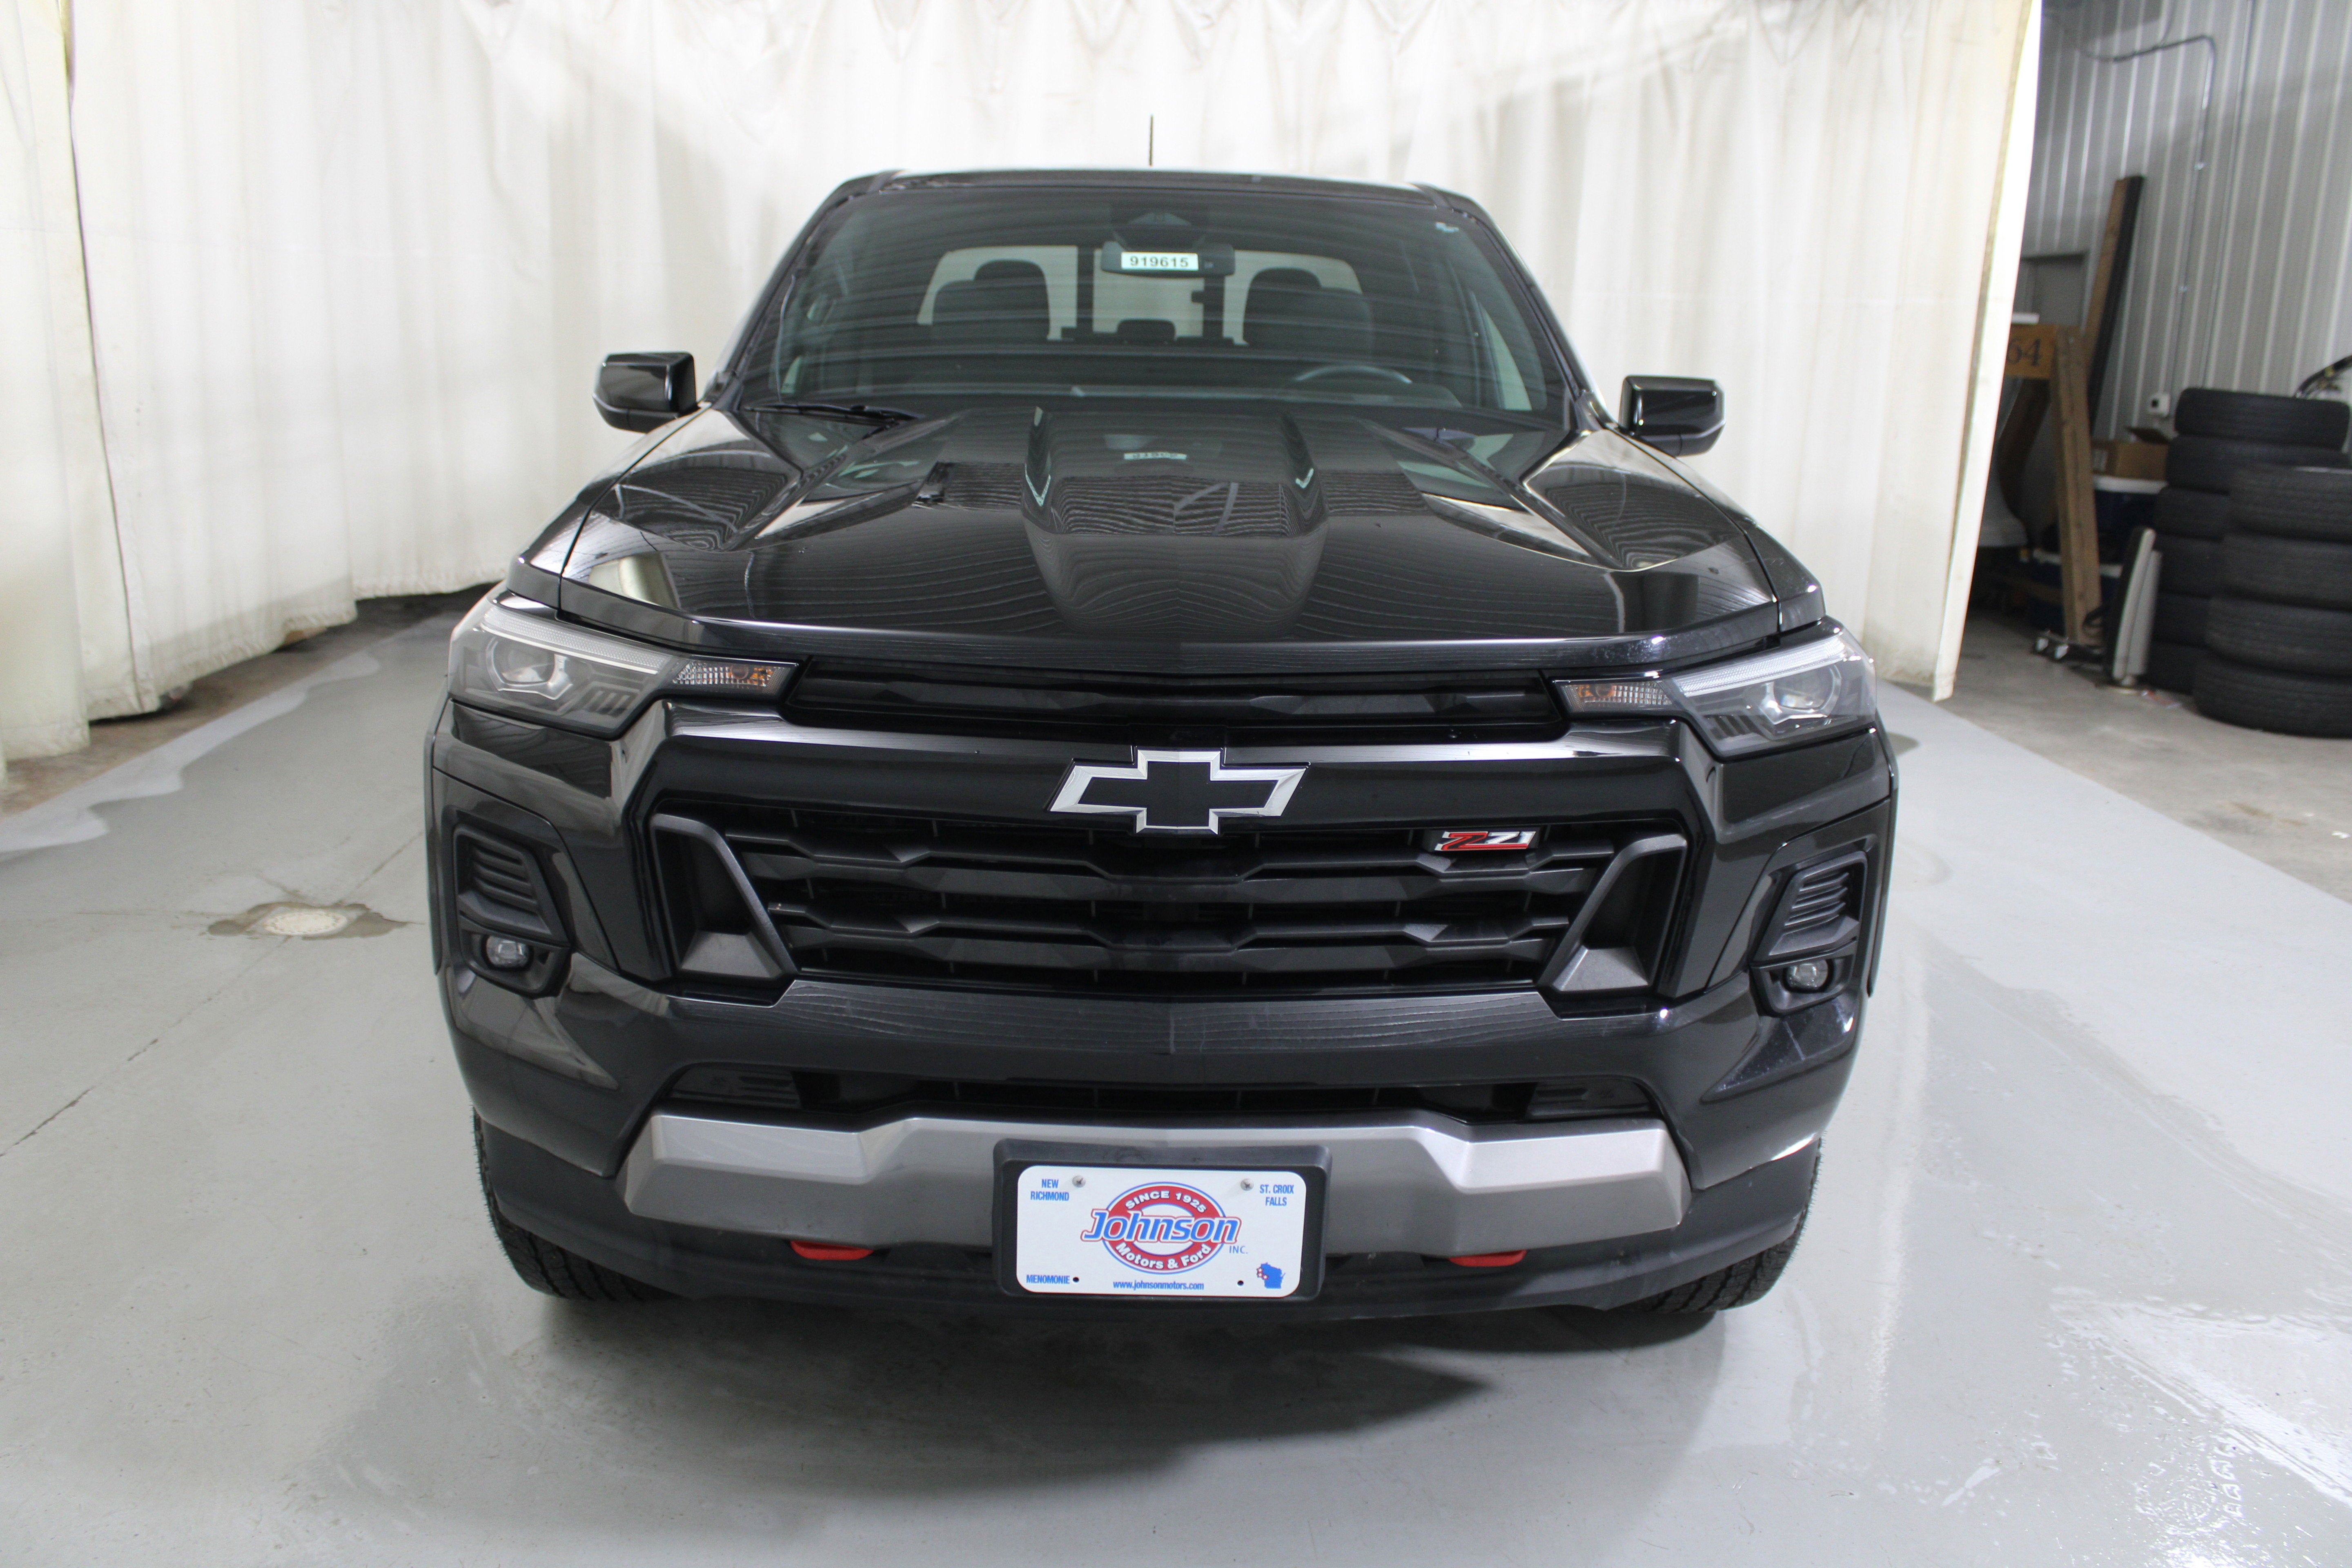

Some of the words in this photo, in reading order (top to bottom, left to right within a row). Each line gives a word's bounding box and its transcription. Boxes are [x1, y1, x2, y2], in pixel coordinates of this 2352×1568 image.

[1130, 256, 1189, 267] 919615
[1434, 831, 1536, 851] Z71
[1041, 1178, 1059, 1188] NEW
[1260, 1184, 1271, 1194] ST.
[1273, 1184, 1294, 1194] CROIX
[1030, 1191, 1069, 1201] RICHMOND
[1125, 1190, 1170, 1209] SINCE
[1175, 1192, 1207, 1213] 1925
[1265, 1197, 1287, 1206] FALLS
[1082, 1210, 1240, 1243] Johnson
[1229, 1245, 1248, 1254] INC.
[1115, 1242, 1164, 1270] Motors
[1167, 1258, 1179, 1269] &
[1181, 1243, 1212, 1267] Ford
[1026, 1274, 1070, 1285] MENOMONIE
[1113, 1281, 1205, 1291] www.johnsonmotors.com
